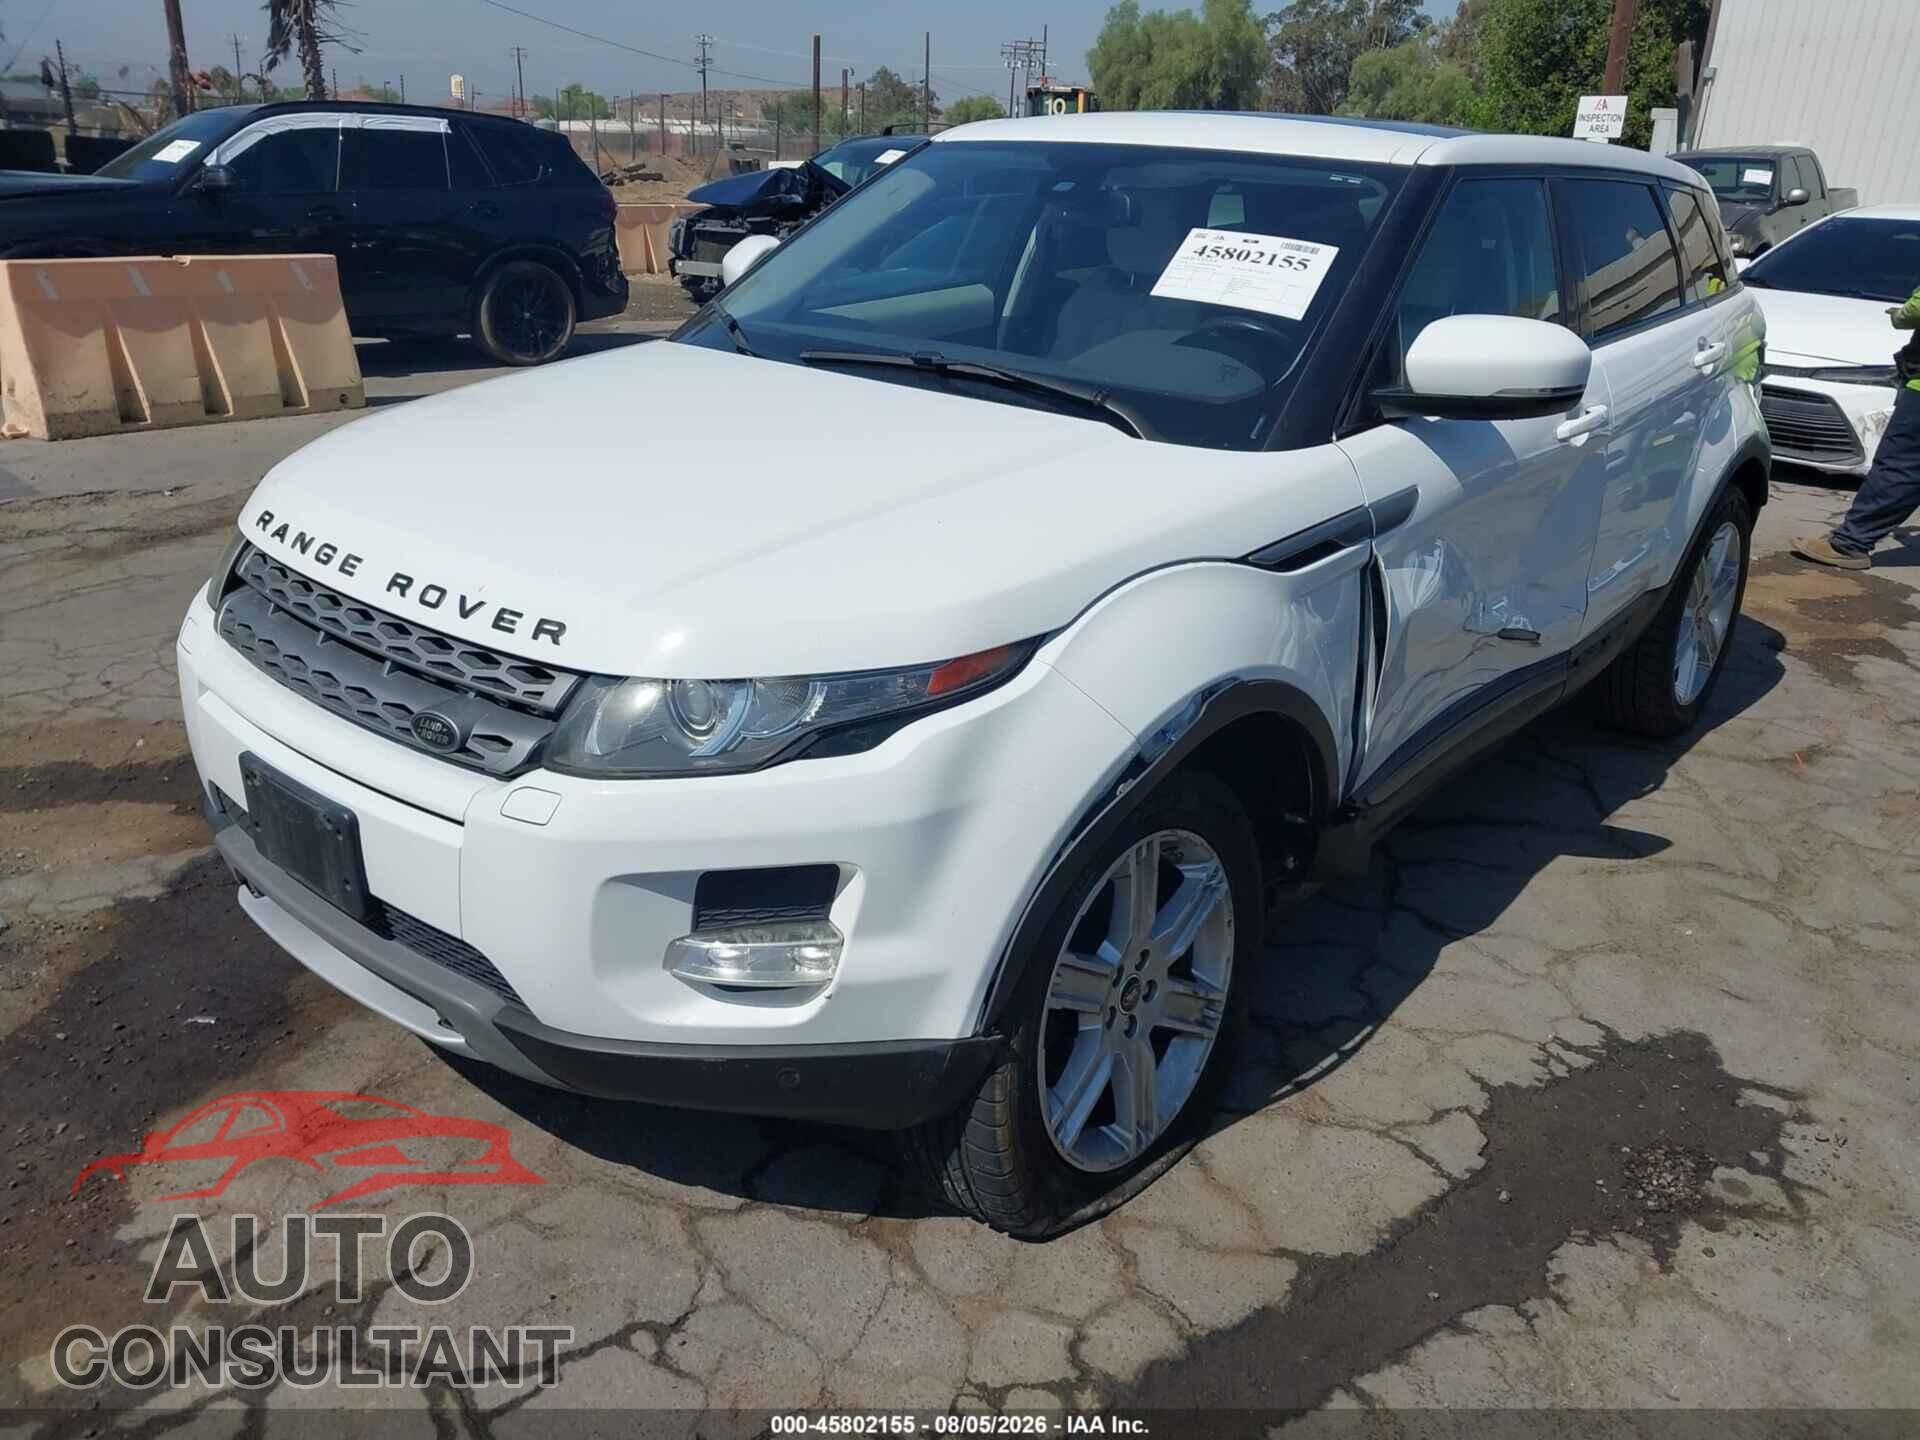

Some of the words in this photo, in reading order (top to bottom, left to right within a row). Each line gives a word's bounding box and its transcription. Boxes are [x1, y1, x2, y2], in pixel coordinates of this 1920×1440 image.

[1579, 113, 1623, 122] INSPECTION
[1589, 124, 1609, 133] AREA
[1193, 244, 1311, 271] 45802155
[255, 510, 363, 577] RANGE
[386, 572, 567, 646] ROVER
